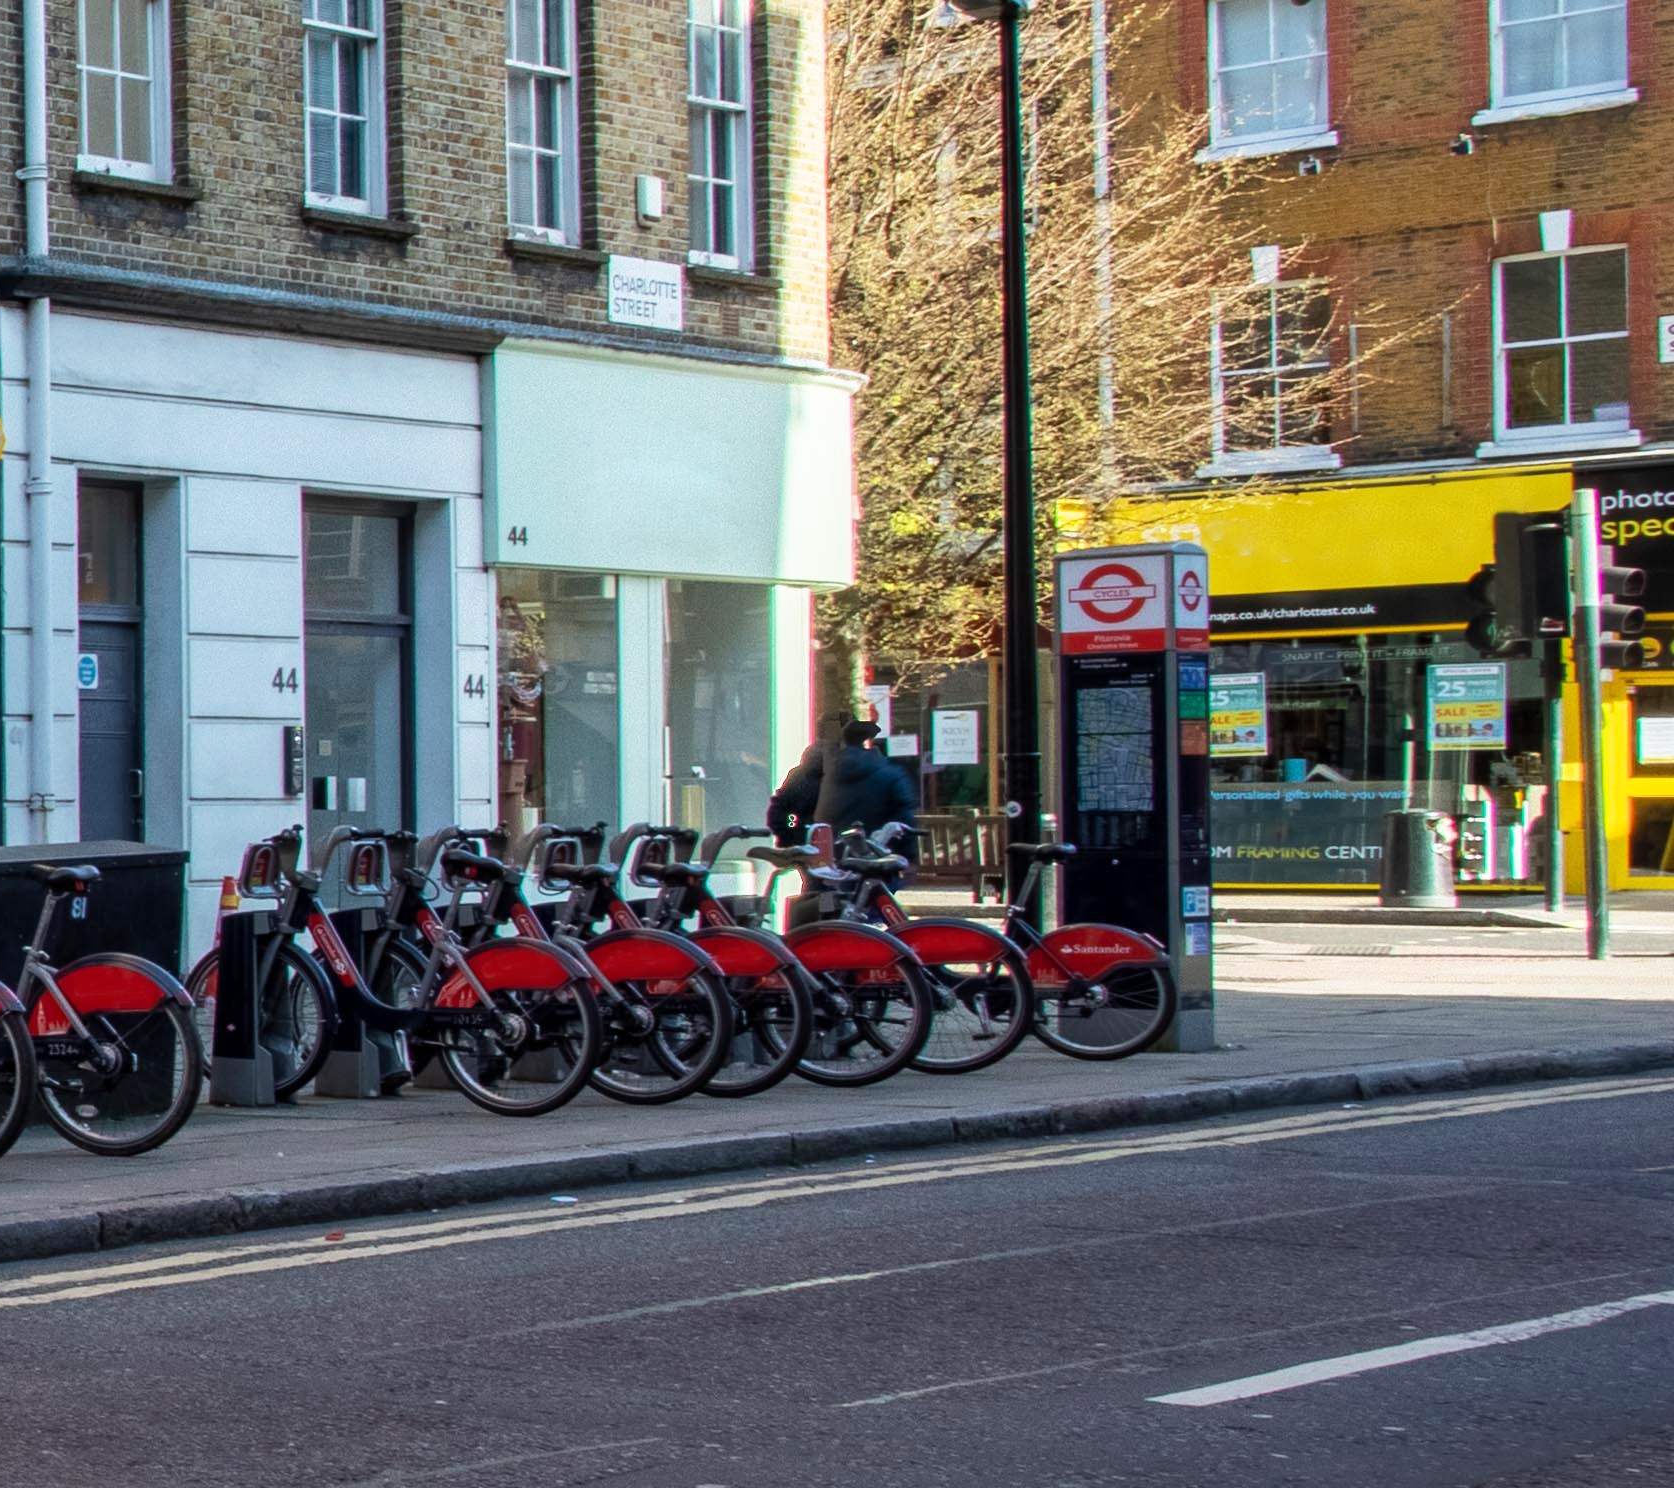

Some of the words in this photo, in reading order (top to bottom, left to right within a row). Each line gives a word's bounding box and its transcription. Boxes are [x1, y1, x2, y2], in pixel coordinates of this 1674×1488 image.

[613, 274, 678, 299] CHARLOTTE
[613, 297, 658, 319] STREET
[508, 526, 527, 546] 44
[1094, 589, 1131, 599] CYCLES
[1208, 604, 1375, 623] naps.co.uk/charlottest.co.uk
[1282, 651, 1312, 662] SNAP
[1314, 651, 1324, 660] IT
[272, 667, 298, 694] 44
[464, 674, 485, 699] 44
[1438, 680, 1466, 697] 25
[1210, 715, 1232, 725] ALE
[1436, 707, 1466, 718] SALE
[1210, 789, 1280, 800] ersonalised
[1282, 789, 1311, 802] gifts
[1313, 789, 1347, 799] while
[1351, 791, 1376, 802] you
[1236, 846, 1320, 859] FRAMING
[1073, 943, 1132, 956] Santander
